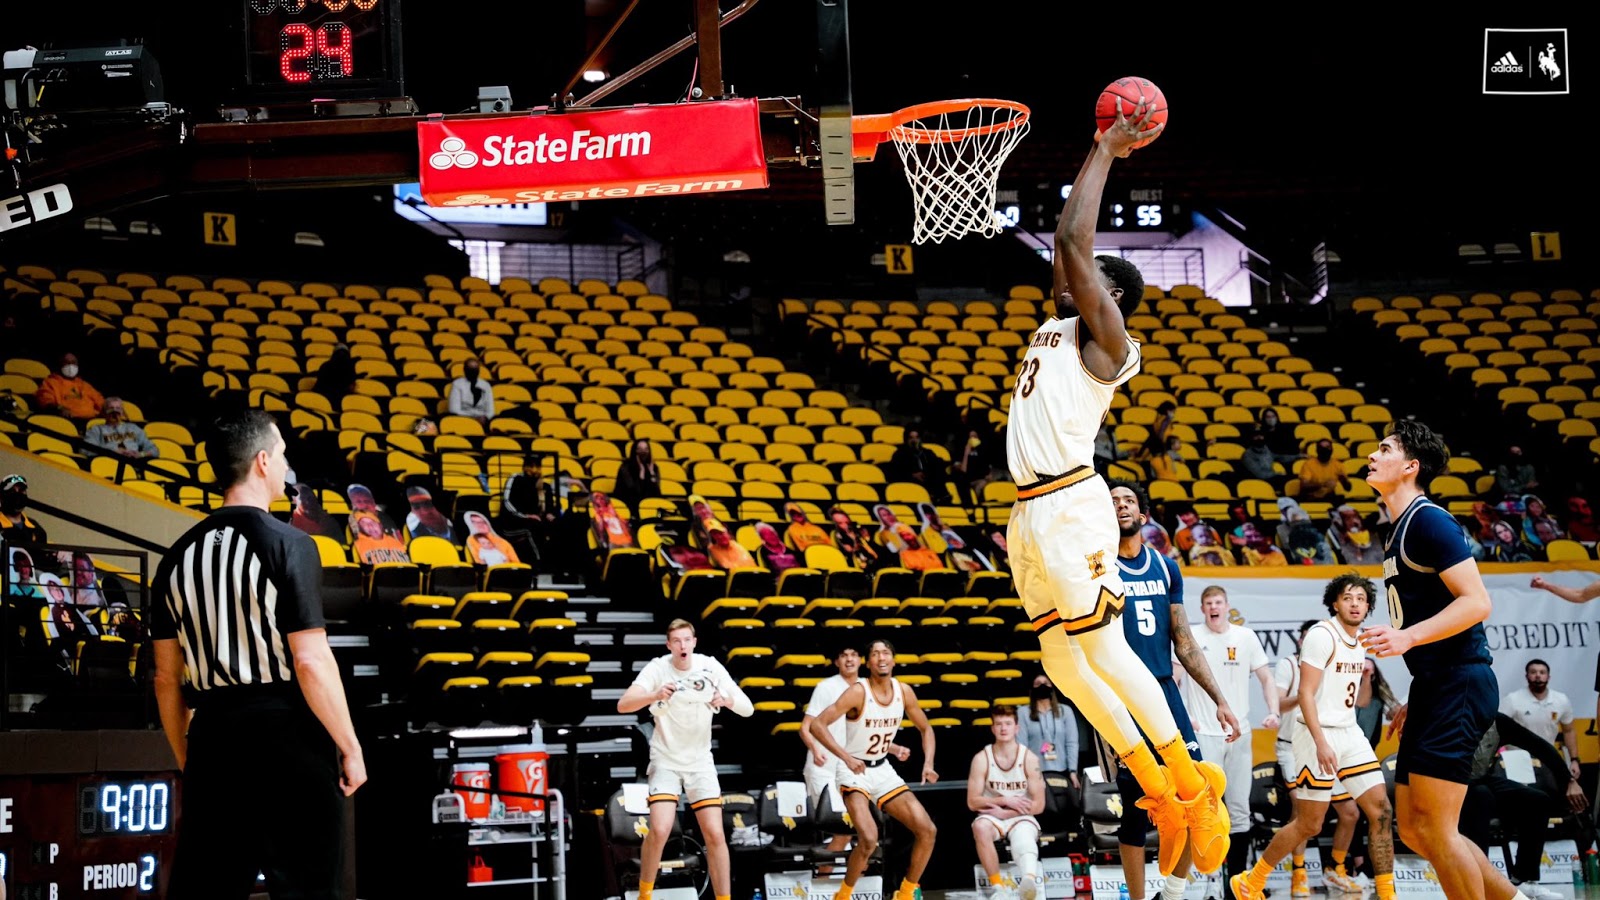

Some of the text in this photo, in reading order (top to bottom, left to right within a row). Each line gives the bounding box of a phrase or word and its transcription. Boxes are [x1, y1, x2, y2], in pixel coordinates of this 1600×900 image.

[281, 24, 352, 82] 24
[1130, 189, 1162, 202] GUEST
[1136, 205, 1162, 226] 55
[211, 215, 229, 242] K
[1538, 235, 1554, 258] L
[892, 248, 908, 271] K
[1134, 600, 1156, 636] 5
[1484, 620, 1590, 651] CREDIT
[1344, 681, 1356, 708] 3
[865, 732, 893, 755] 25
[470, 774, 484, 788] G
[528, 761, 543, 780] G
[988, 780, 1027, 791] WYOMING
[102, 783, 168, 832] 9:00
[50, 843, 60, 864] P
[83, 856, 155, 891] PERIOD 2
[1046, 871, 1072, 879] WYO
[1395, 870, 1424, 880] UNI
[768, 887, 792, 897] UNI
